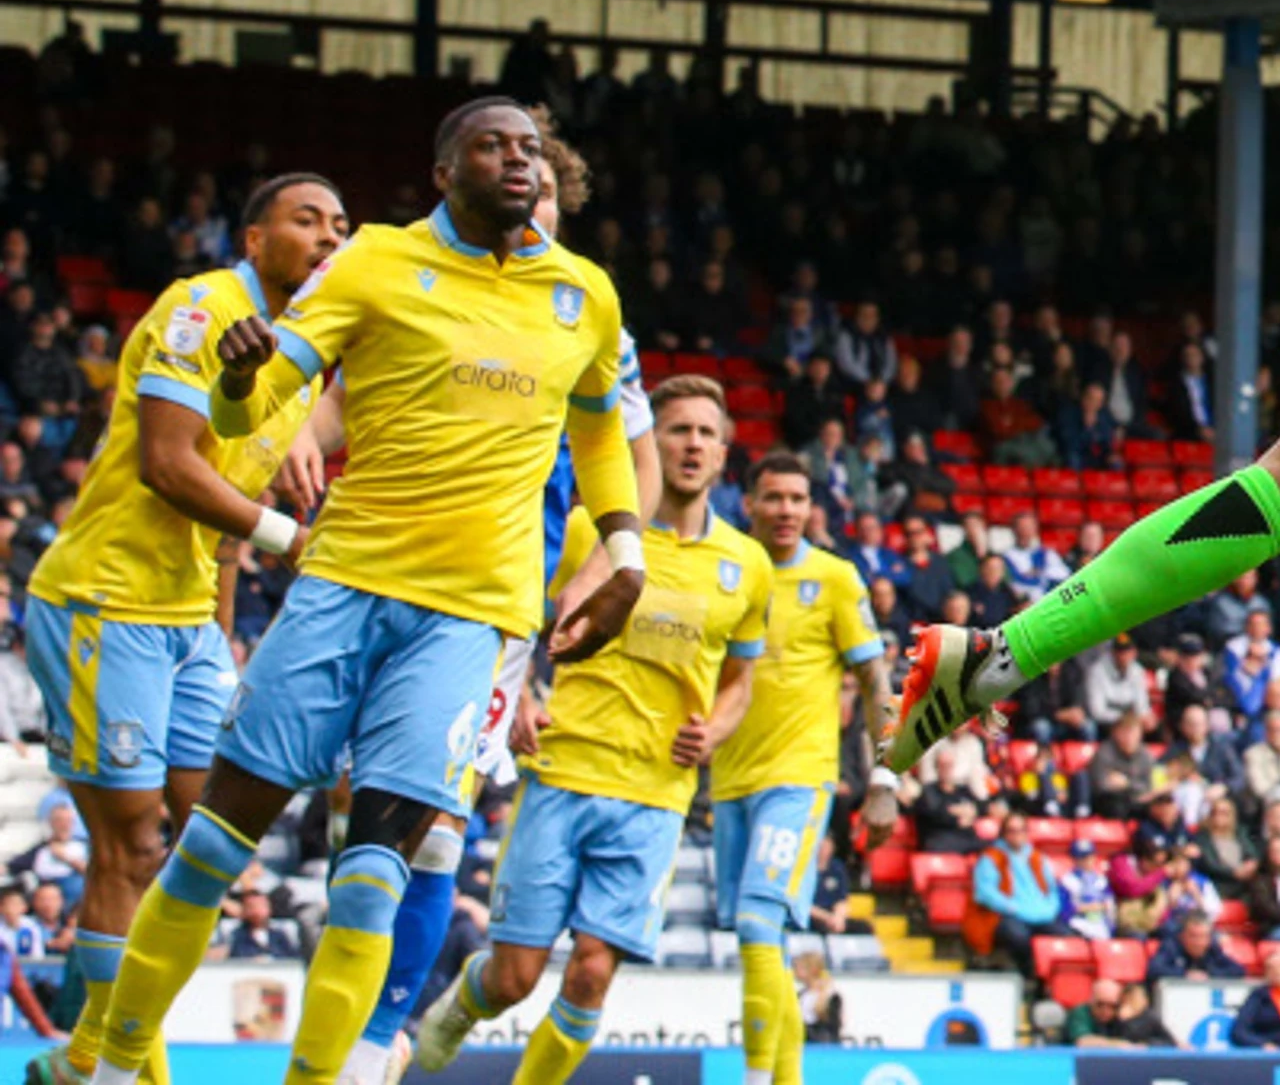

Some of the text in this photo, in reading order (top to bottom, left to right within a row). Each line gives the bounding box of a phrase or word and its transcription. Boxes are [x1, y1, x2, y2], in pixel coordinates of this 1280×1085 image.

[452, 362, 536, 397] cirata
[447, 700, 477, 761] 6
[752, 824, 800, 868] 18
